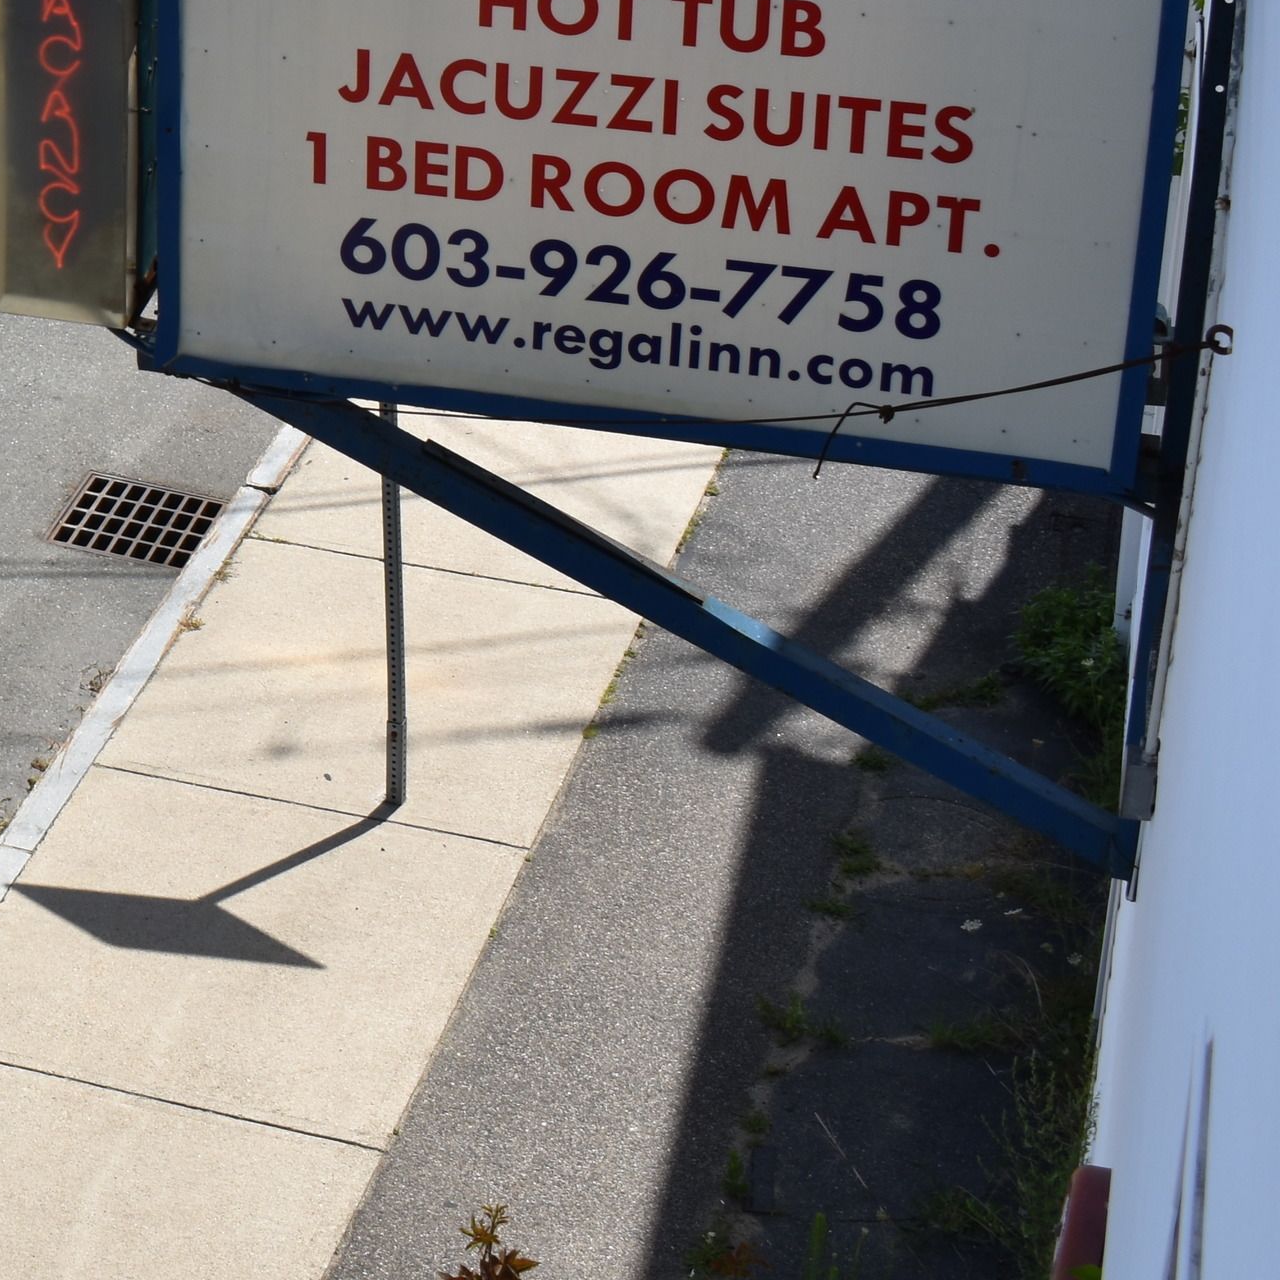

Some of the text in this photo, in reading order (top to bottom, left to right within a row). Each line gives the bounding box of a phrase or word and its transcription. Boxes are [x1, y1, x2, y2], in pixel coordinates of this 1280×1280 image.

[337, 48, 974, 165] JACUZZI SUITES
[307, 131, 1002, 258] 1 BED ROOM APT.
[340, 217, 943, 341] 603-926-7758
[342, 297, 935, 398] www.regalinn.com
